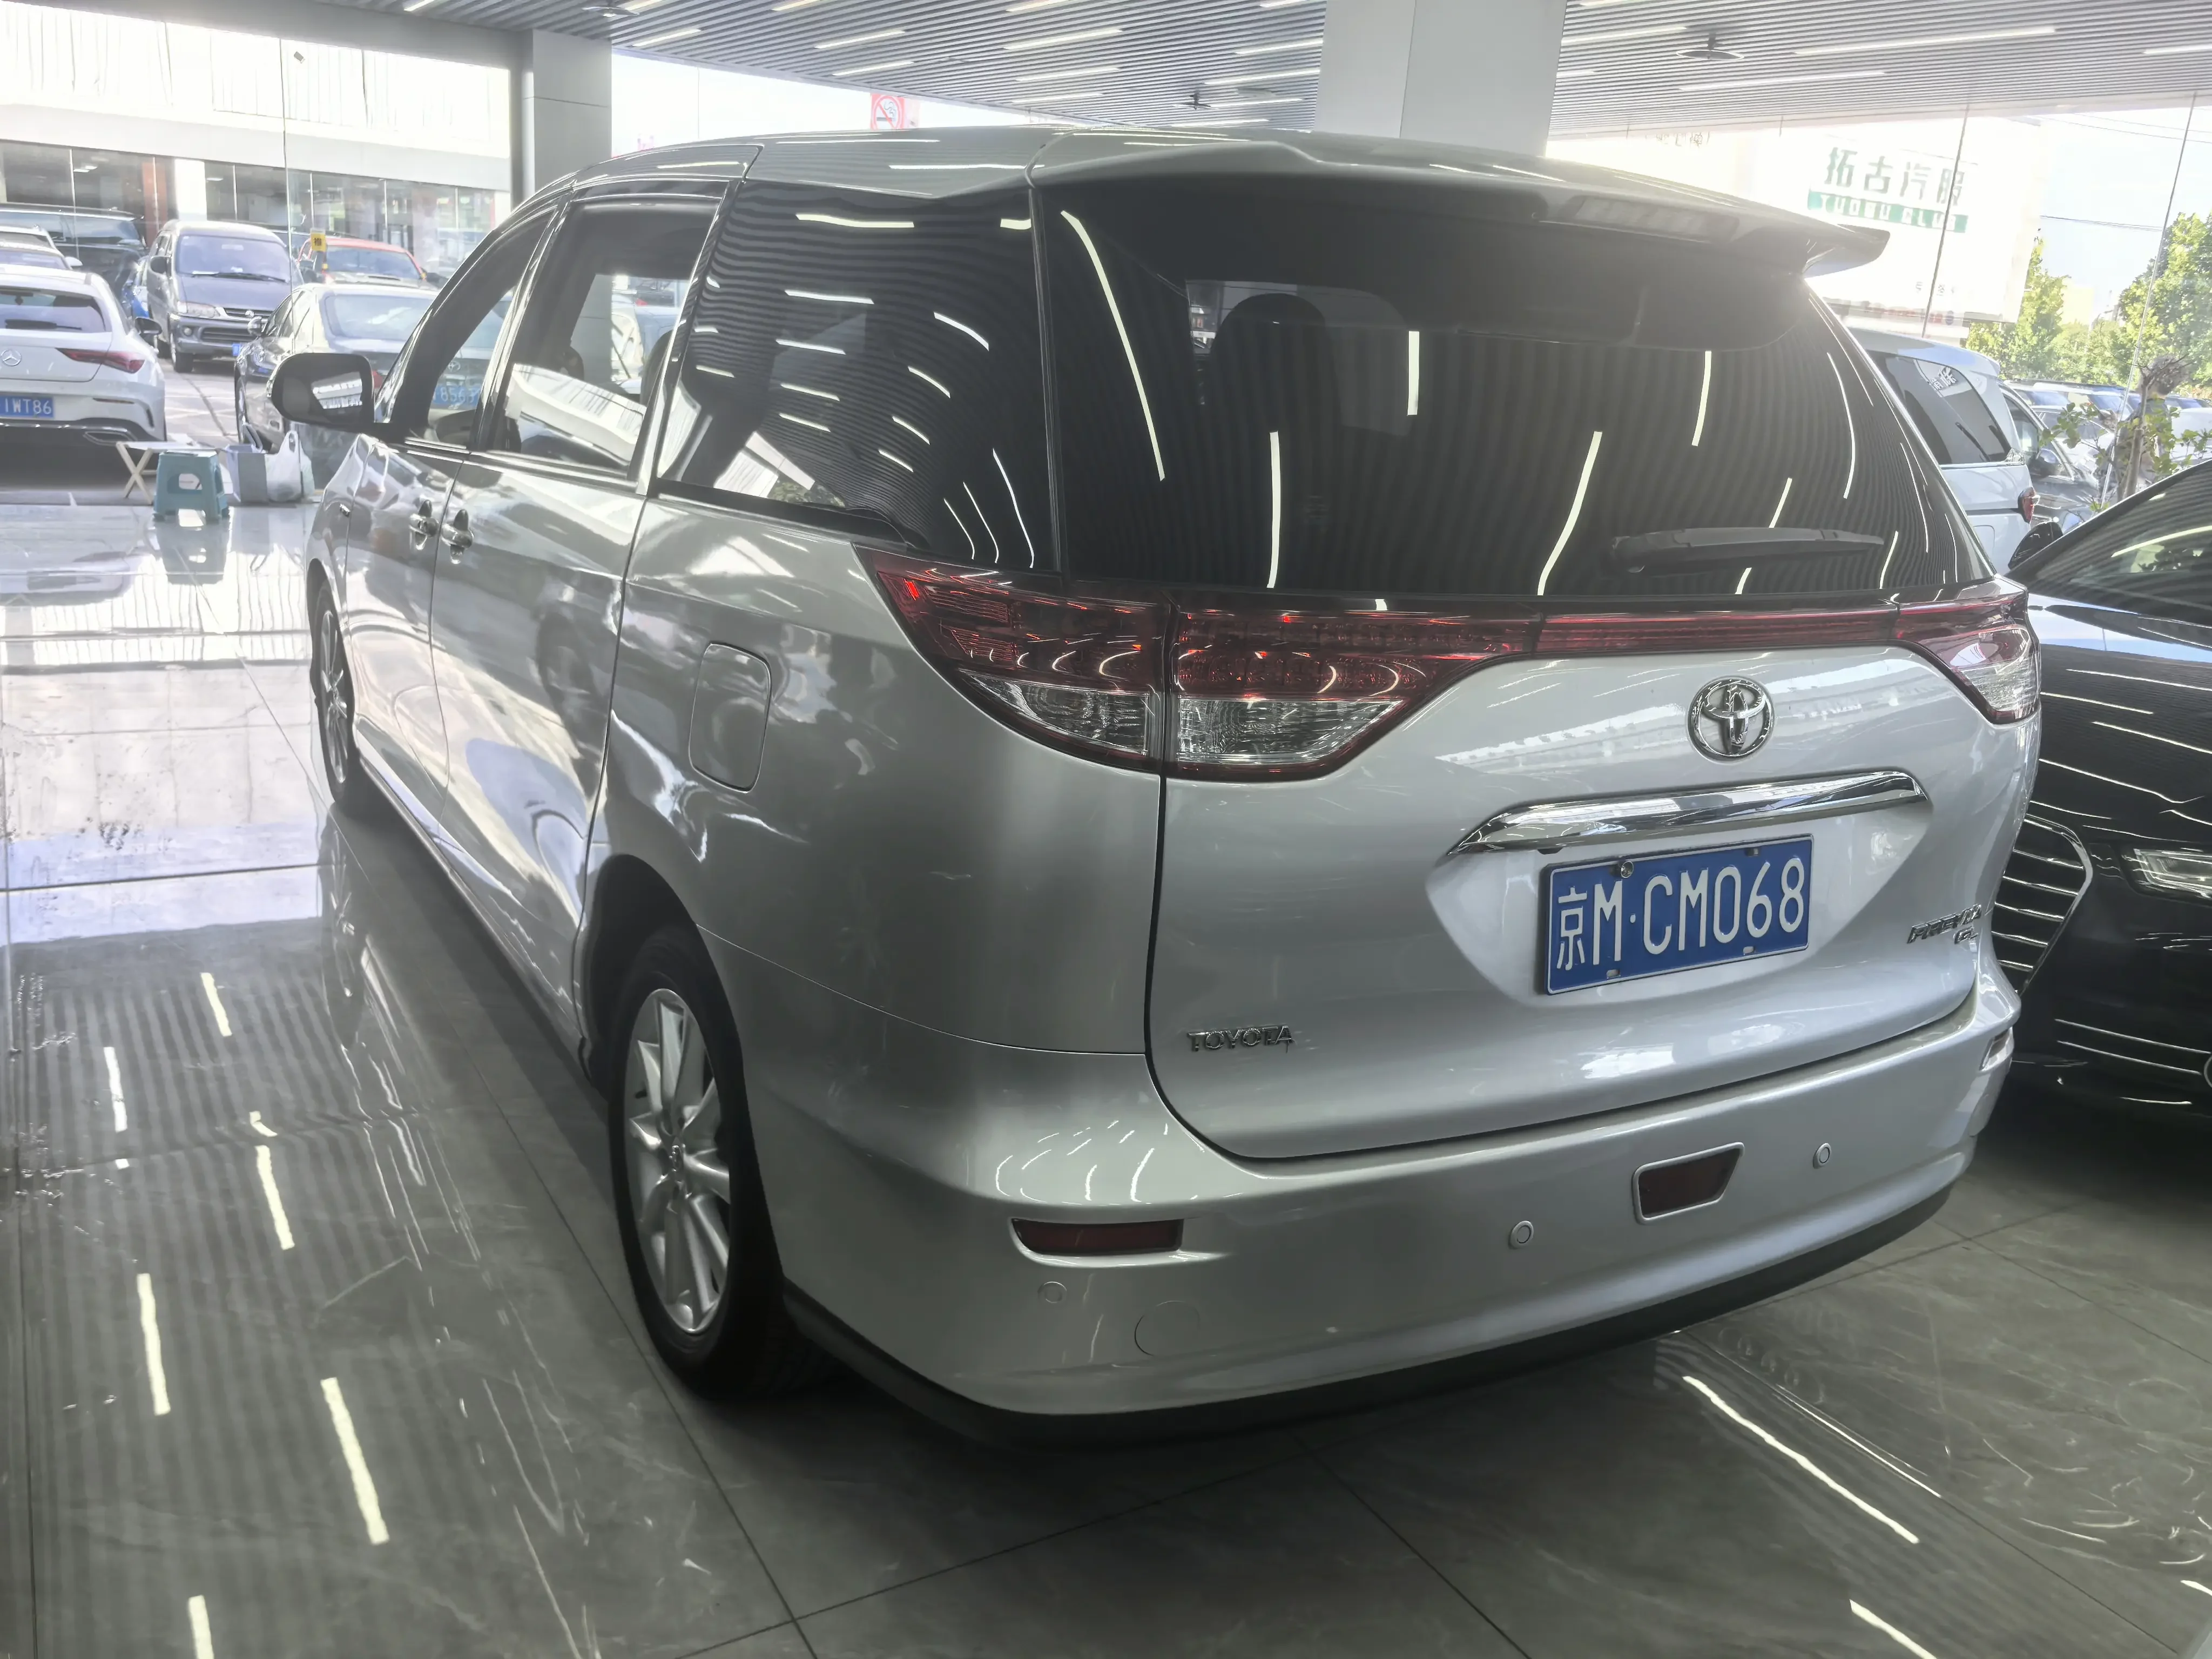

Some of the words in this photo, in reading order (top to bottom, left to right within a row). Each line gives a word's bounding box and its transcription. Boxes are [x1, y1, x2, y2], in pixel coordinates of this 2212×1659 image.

[1824, 147, 1965, 206] 拓古汽服
[1187, 1025, 1293, 1051] TOYOTA
